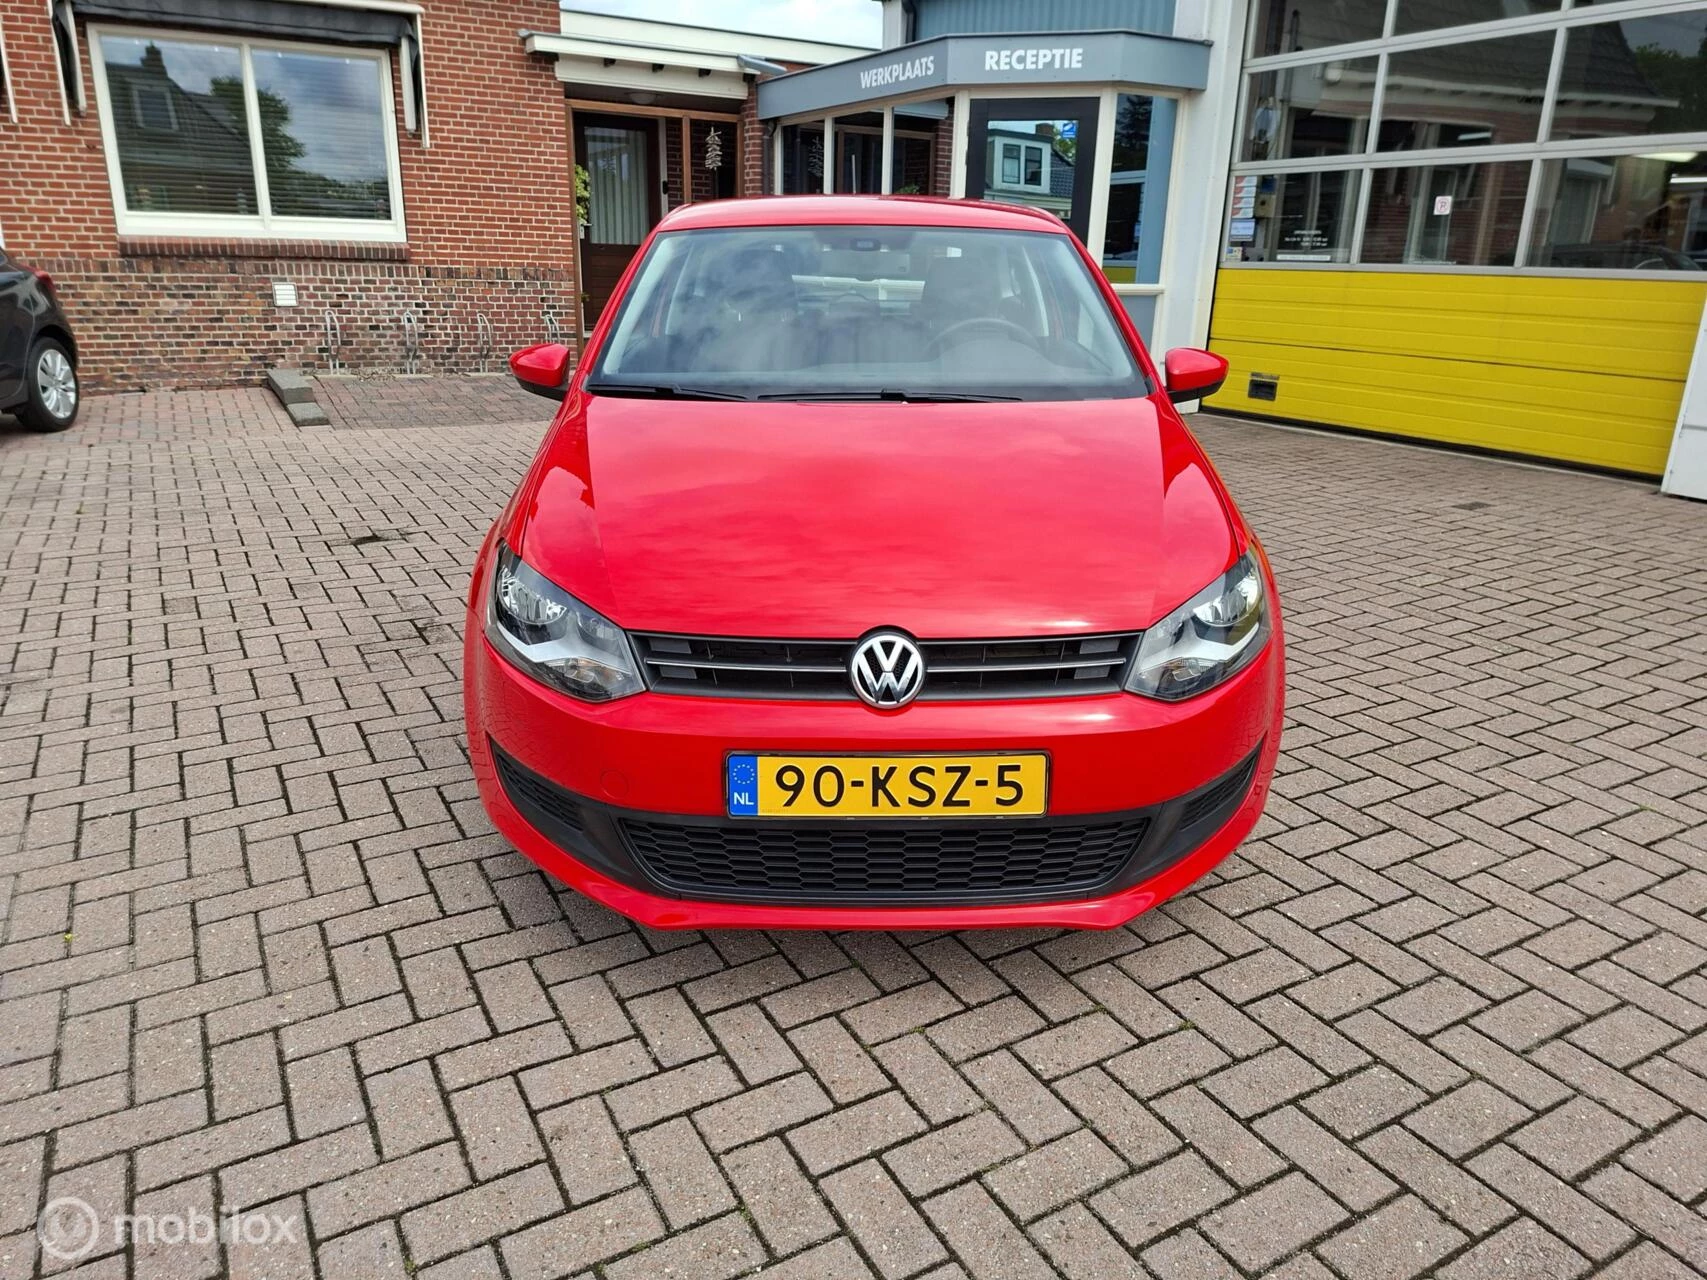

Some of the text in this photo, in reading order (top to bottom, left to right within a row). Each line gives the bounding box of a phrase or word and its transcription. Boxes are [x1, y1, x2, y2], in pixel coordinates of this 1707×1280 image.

[860, 55, 935, 89] WERKPLAATS
[984, 47, 1084, 72] RECEPTIE
[733, 792, 754, 806] NL
[775, 764, 1024, 808] 90-KSZ-5
